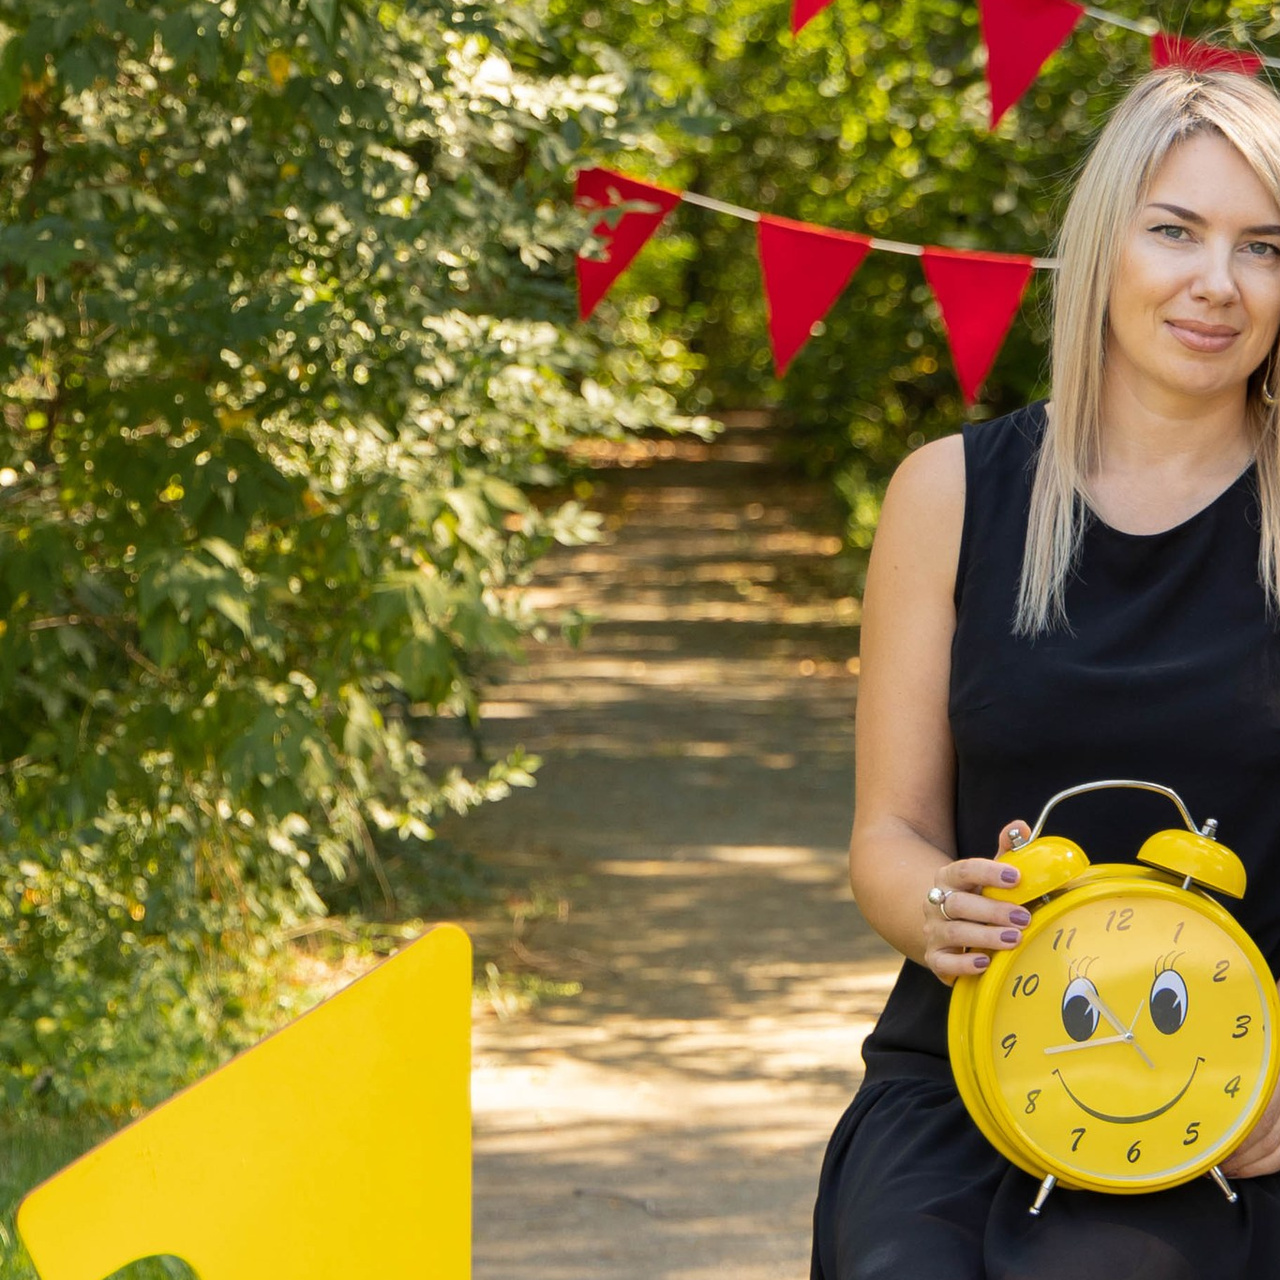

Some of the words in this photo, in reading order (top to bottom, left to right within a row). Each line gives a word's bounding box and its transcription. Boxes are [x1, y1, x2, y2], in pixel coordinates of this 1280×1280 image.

[1105, 908, 1133, 931] 12
[1052, 927, 1076, 951] 11
[1173, 921, 1184, 943] 1
[1212, 959, 1230, 982] 2
[1012, 973, 1039, 997] 10
[1232, 1015, 1251, 1039] 3
[1001, 1033, 1017, 1058] 9
[1224, 1075, 1240, 1098] 4
[1024, 1088, 1041, 1114] 8
[1070, 1128, 1086, 1152] 7
[1183, 1122, 1200, 1146] 5
[1127, 1140, 1141, 1163] 6
